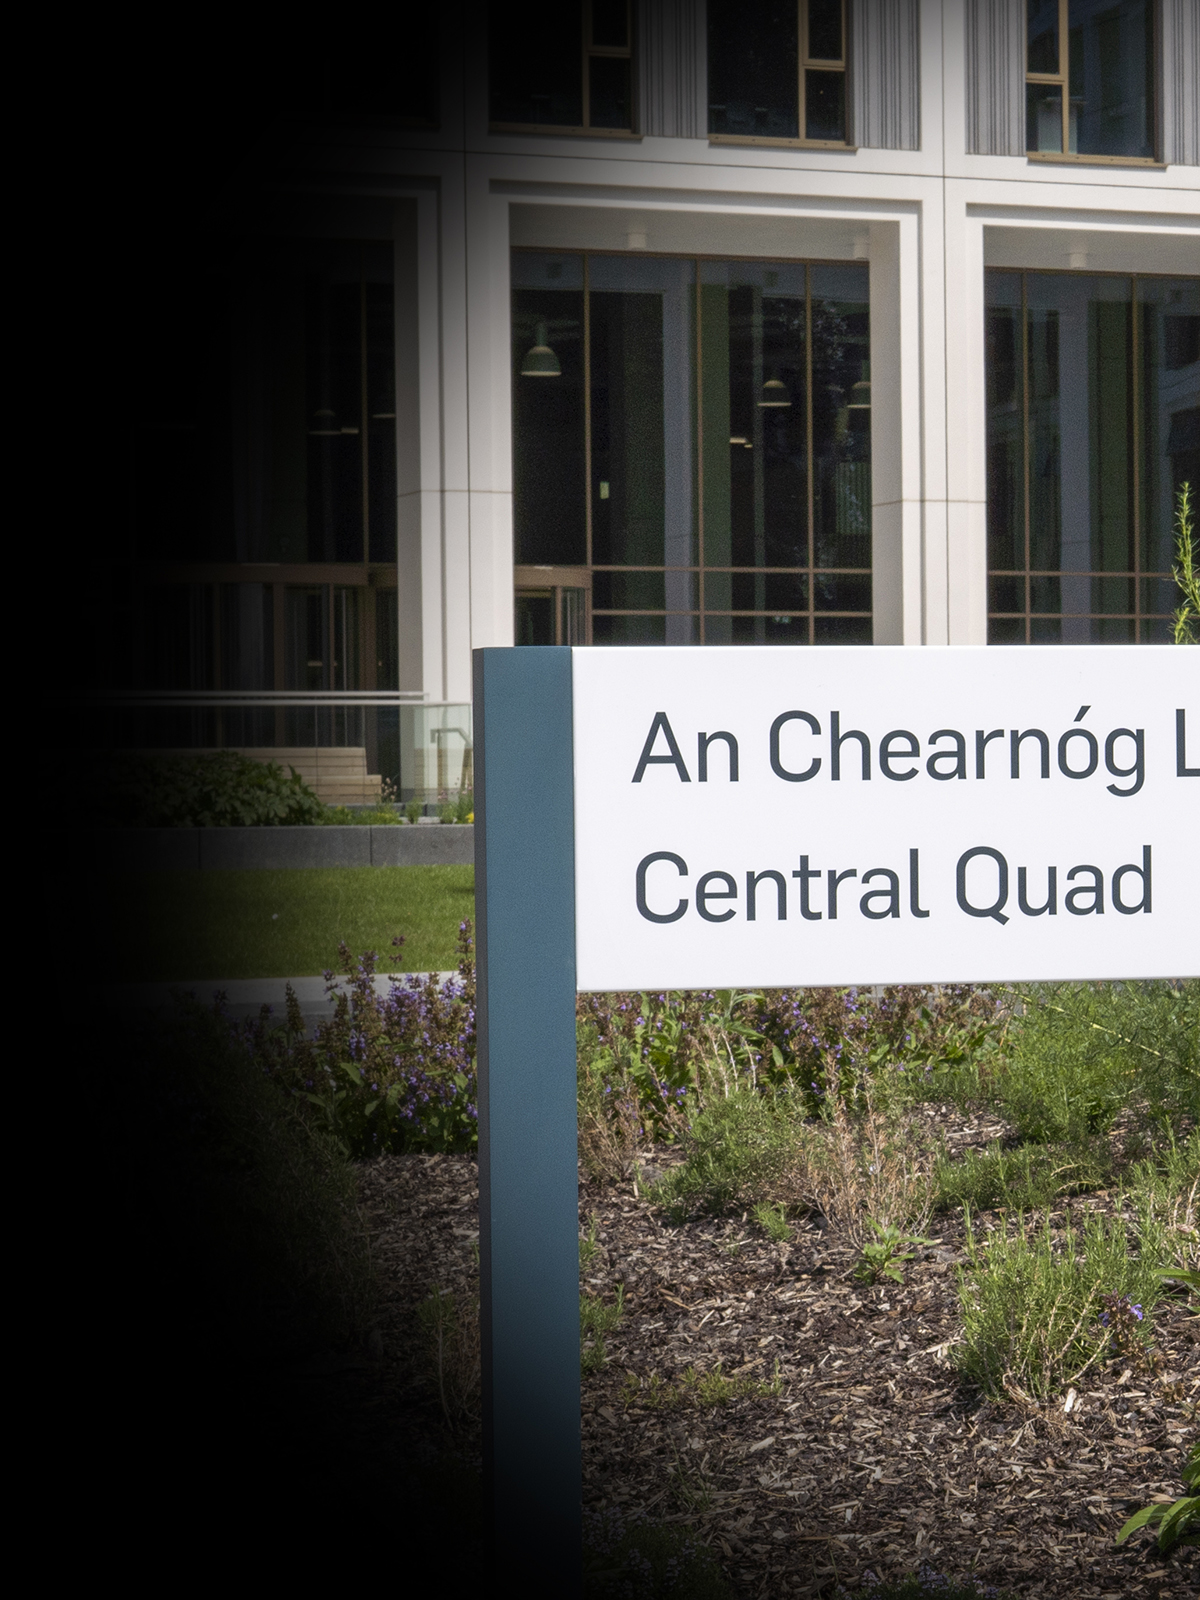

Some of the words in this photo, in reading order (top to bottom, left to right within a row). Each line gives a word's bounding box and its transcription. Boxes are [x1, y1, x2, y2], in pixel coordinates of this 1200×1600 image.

[631, 711, 739, 783] An
[769, 705, 1145, 798] Chearnóg
[635, 844, 930, 924] Central
[956, 844, 1152, 926] Quad
